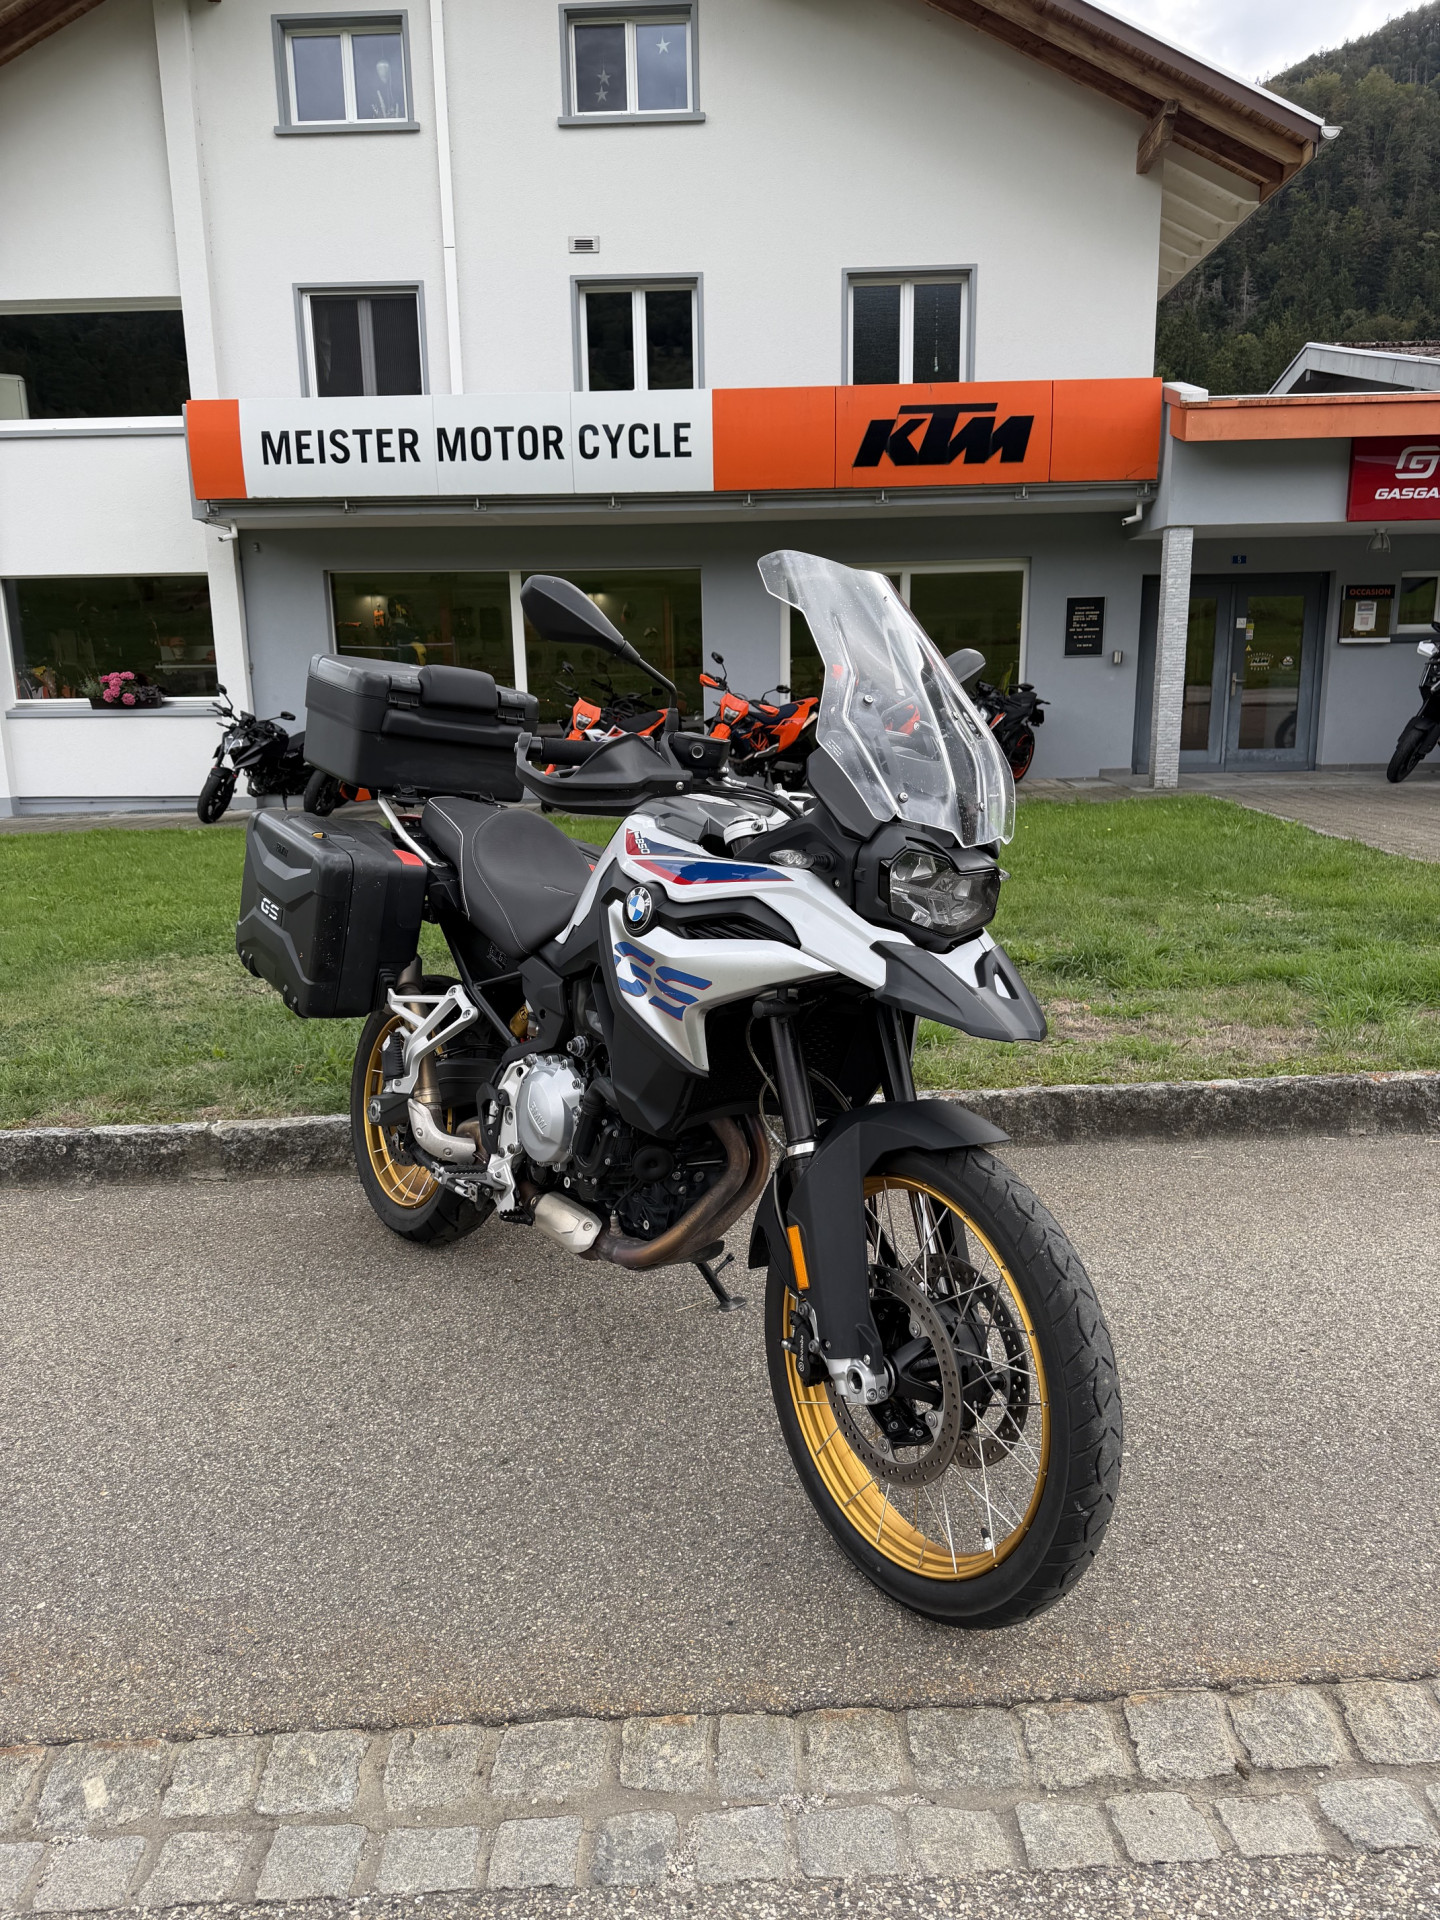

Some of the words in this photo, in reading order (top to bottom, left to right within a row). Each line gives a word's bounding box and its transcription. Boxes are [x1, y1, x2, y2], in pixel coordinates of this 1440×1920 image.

[261, 428, 421, 466] MEISTER
[437, 425, 566, 462] MOTOR
[577, 421, 692, 459] CYCLE
[853, 402, 1035, 468] KTM
[1374, 487, 1440, 500] GASGA
[1349, 588, 1391, 596] OCCASION
[260, 897, 280, 920] GS
[613, 941, 713, 1021] GS
